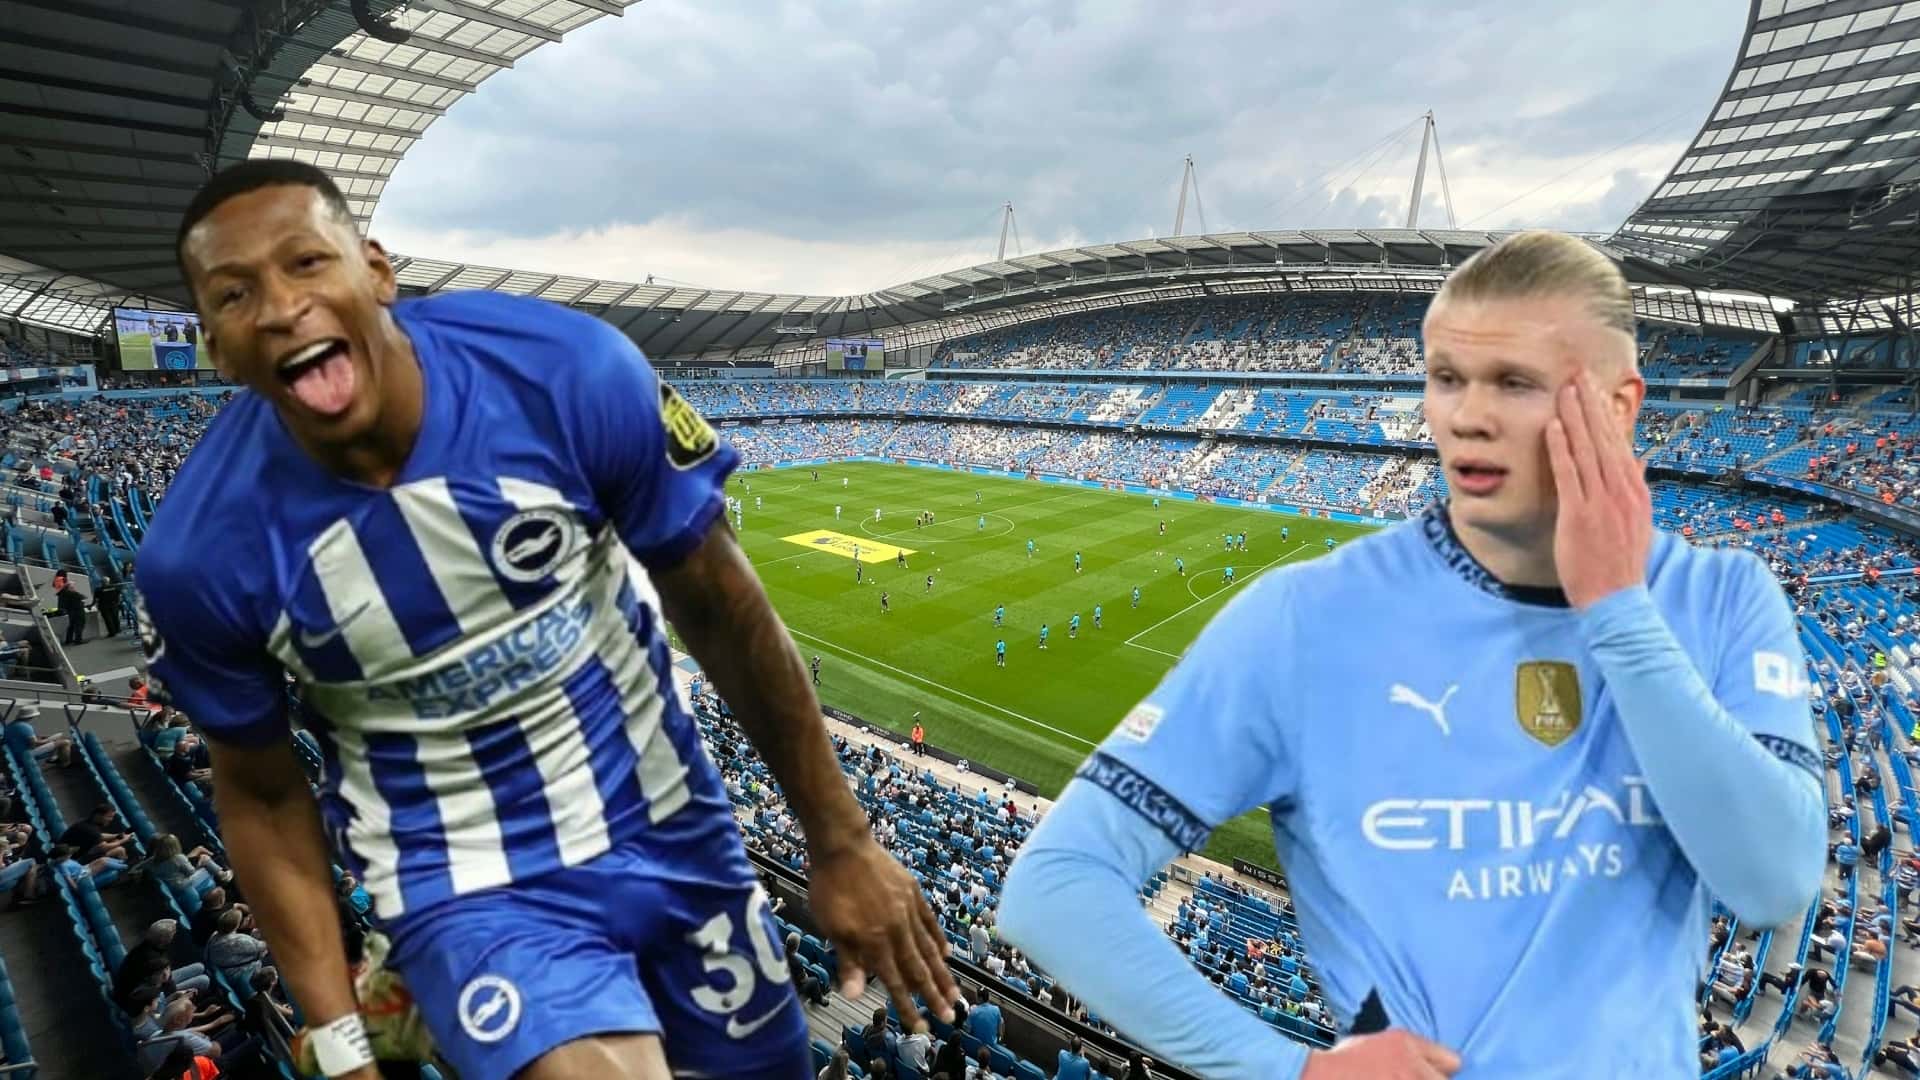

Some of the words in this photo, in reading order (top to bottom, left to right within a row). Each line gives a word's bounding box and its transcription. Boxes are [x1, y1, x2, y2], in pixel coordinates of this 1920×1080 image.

[1242, 864, 1288, 888] NISSA
[1447, 844, 1623, 900] AIRWAYS
[686, 879, 791, 1015] 30
